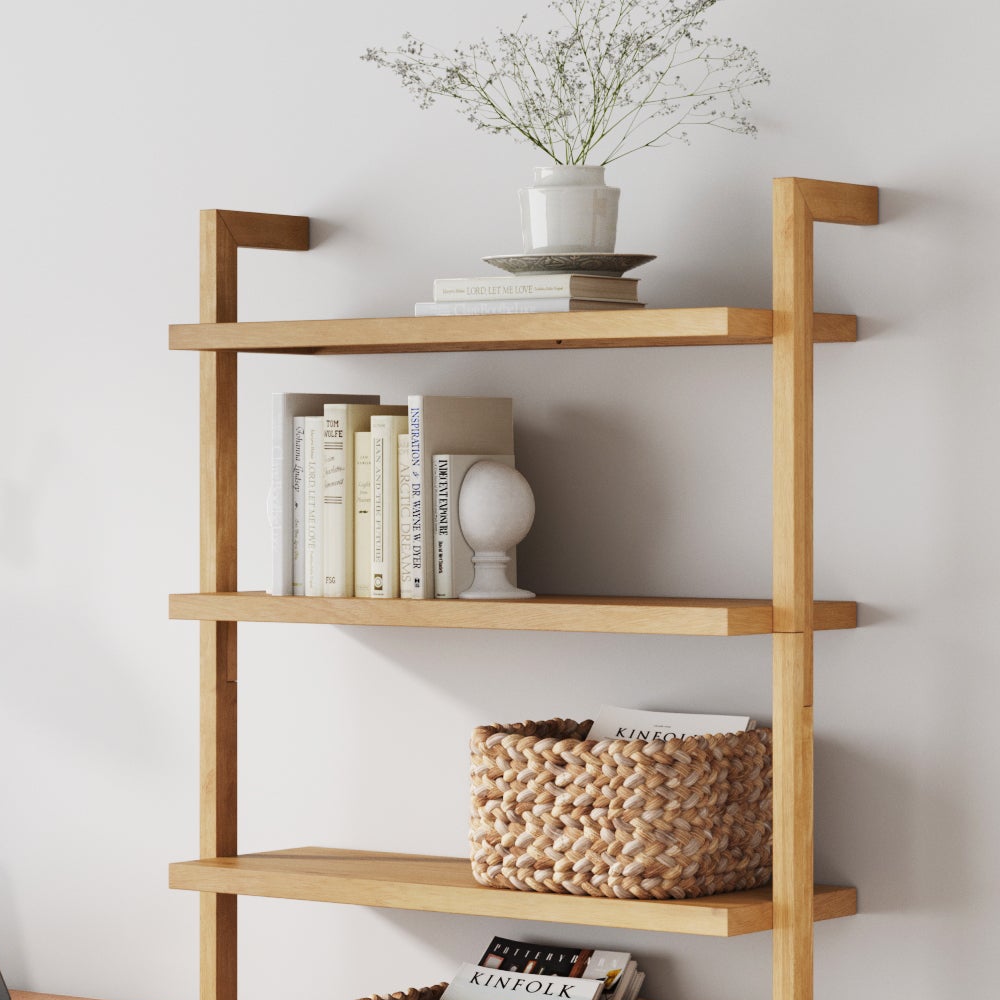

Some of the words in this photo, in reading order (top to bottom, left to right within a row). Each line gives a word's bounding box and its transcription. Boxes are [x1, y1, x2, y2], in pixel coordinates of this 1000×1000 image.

[488, 286, 501, 295] LET
[503, 285, 514, 294] ME
[324, 430, 343, 438] WOLFE
[326, 420, 339, 428] TOM
[410, 408, 420, 466] INSPIRATION
[295, 426, 305, 461] Johanna
[399, 463, 411, 517] ARCTIC
[438, 459, 448, 497] INDECENT
[412, 500, 421, 532] WAYNE
[438, 498, 448, 536] EXPOSURE
[401, 523, 412, 582] DREAMS
[412, 545, 421, 569] DYER
[325, 576, 336, 584] FSG
[468, 971, 576, 999] KINFOLK
